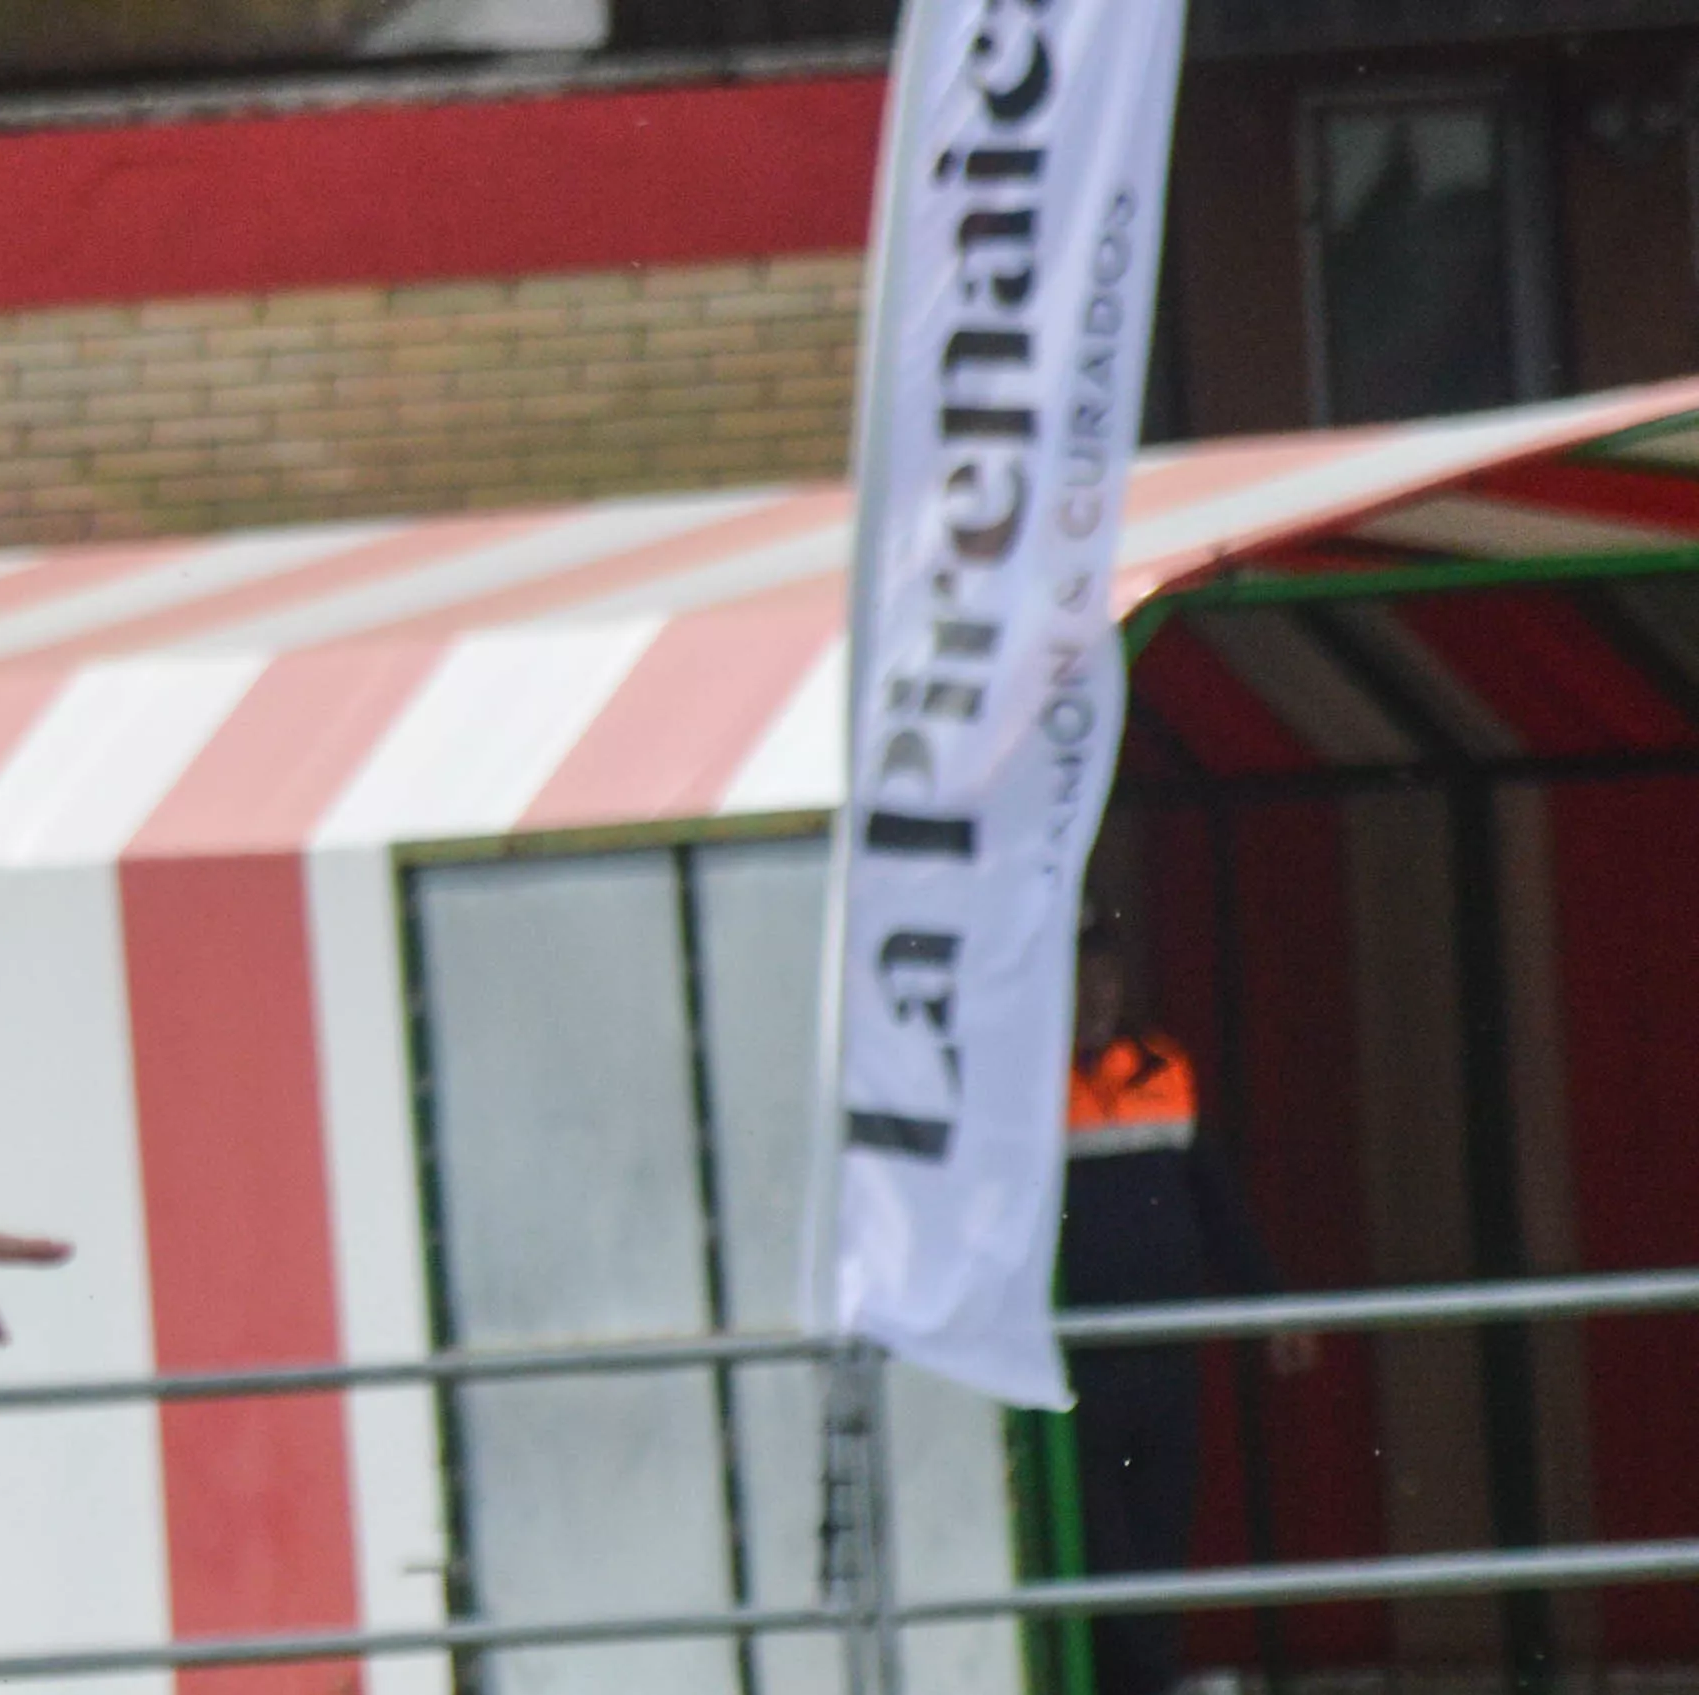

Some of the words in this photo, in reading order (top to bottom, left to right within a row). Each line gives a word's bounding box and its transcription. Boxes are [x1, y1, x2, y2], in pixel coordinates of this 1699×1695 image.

[865, 0, 1053, 858] Pirenaic
[1057, 188, 1138, 540] CURADOS
[847, 931, 964, 1164] La
